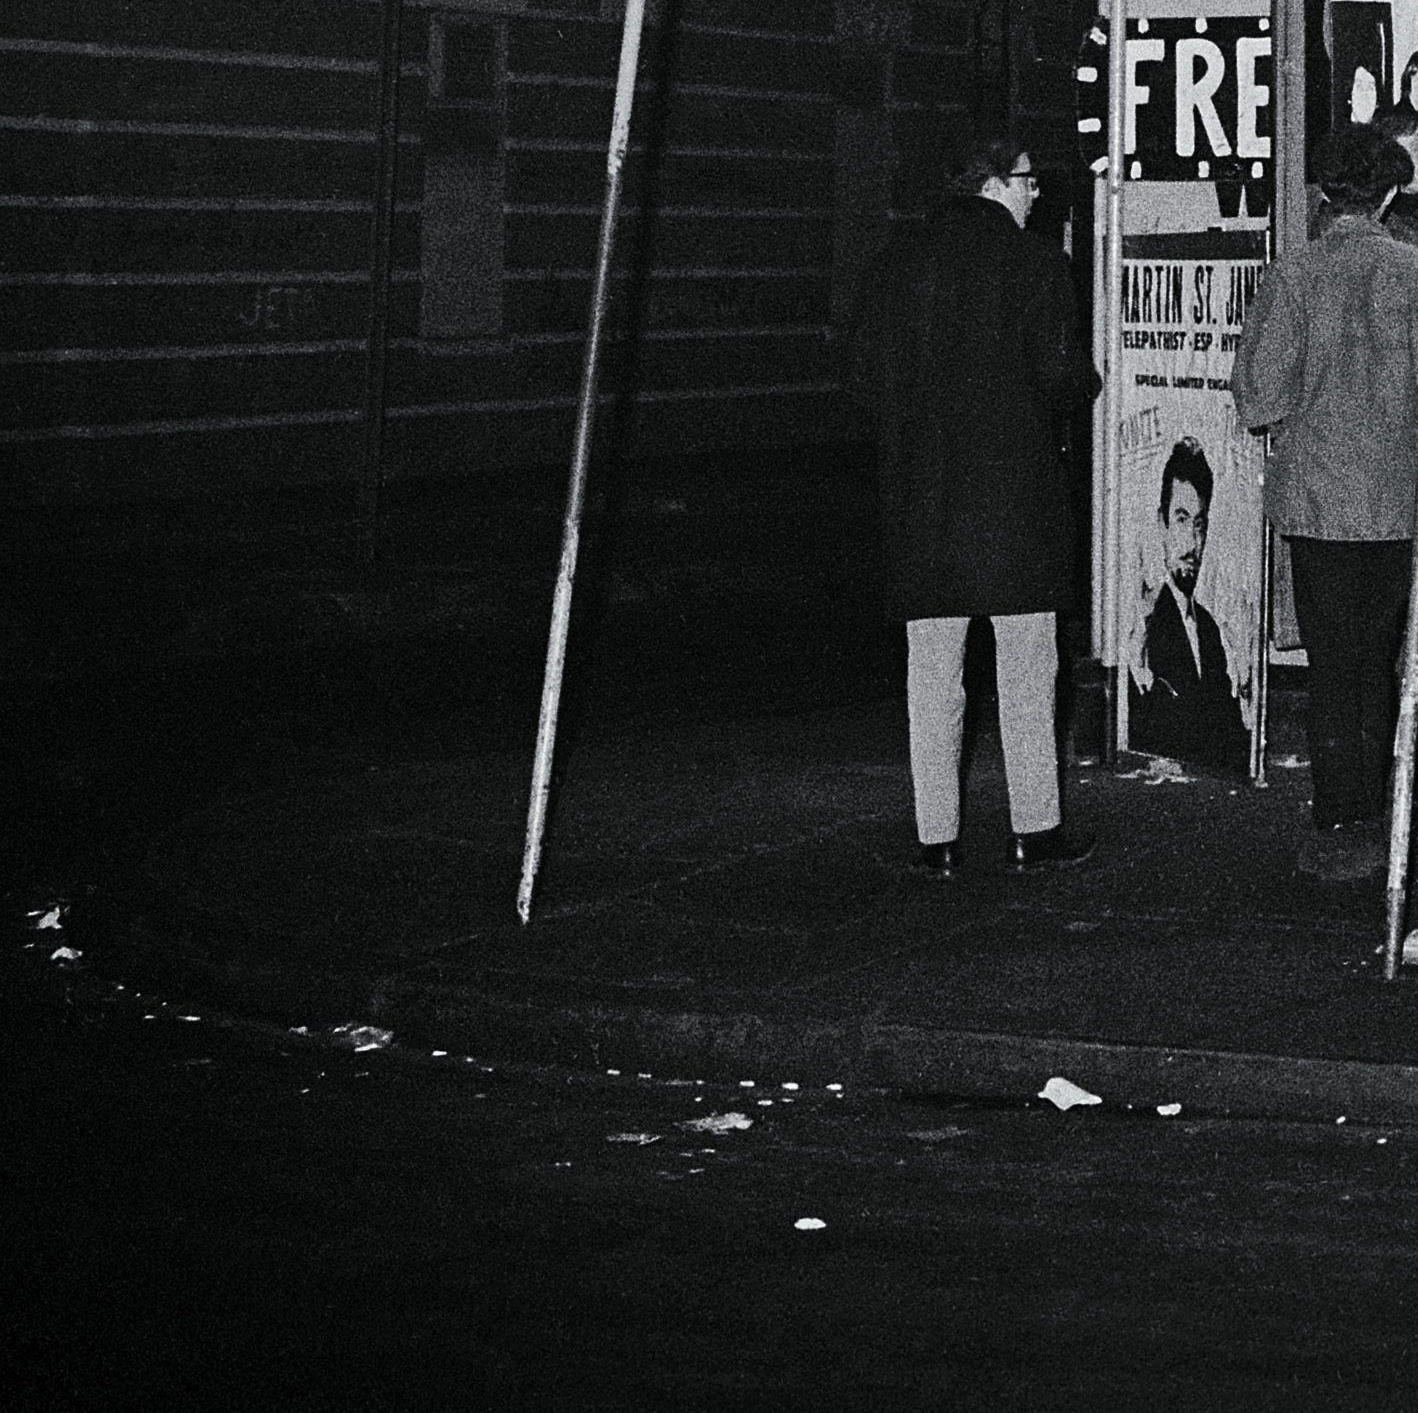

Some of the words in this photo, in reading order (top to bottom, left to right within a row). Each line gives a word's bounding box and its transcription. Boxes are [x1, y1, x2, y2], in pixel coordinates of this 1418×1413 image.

[1193, 264, 1218, 325] ST.
[1120, 330, 1187, 351] ELEPATHIST
[1193, 331, 1213, 352] ESP
[1134, 373, 1169, 388] SPECIAL
[1172, 375, 1205, 390] LIMITED
